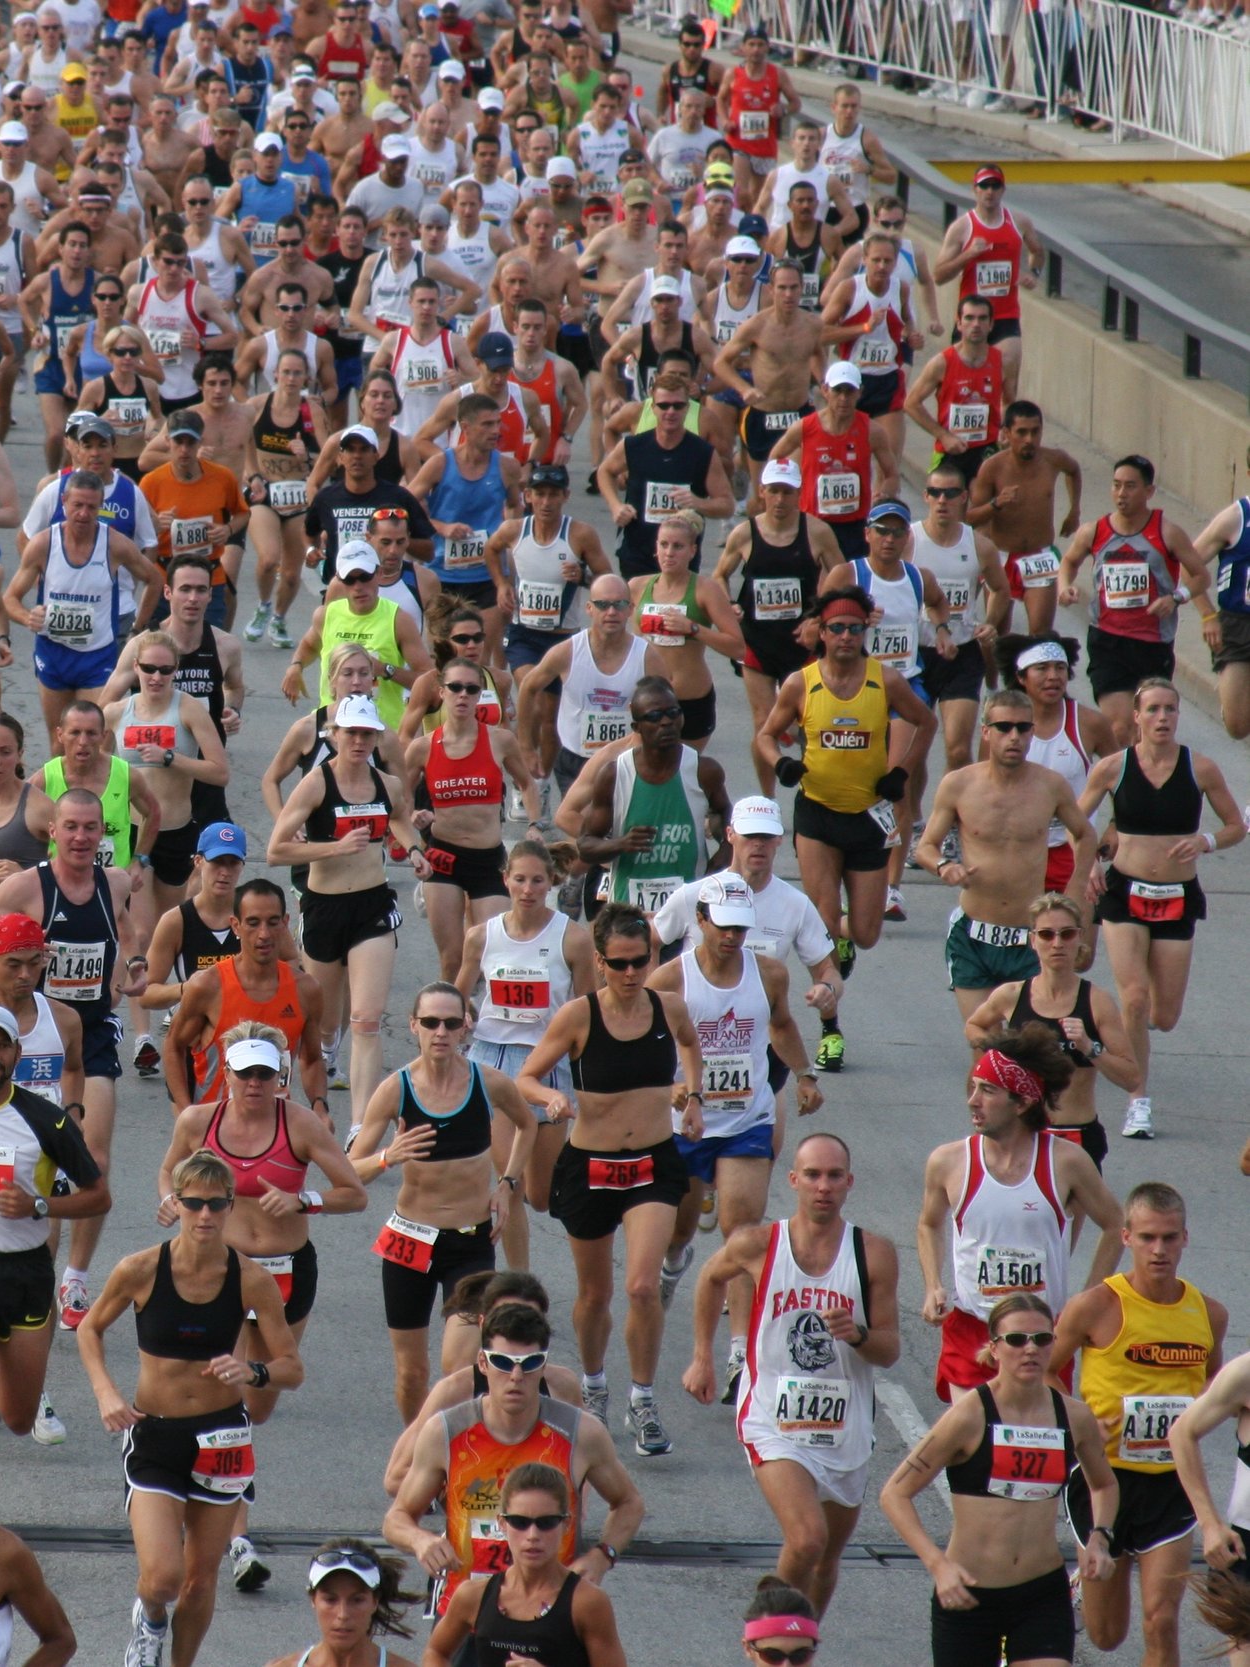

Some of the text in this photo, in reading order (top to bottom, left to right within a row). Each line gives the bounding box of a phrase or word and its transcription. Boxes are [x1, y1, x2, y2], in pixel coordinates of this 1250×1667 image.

[861, 349, 888, 363] A 817
[408, 366, 438, 380] A 906
[123, 408, 143, 423] 988
[954, 413, 984, 428] A 862
[823, 484, 855, 499] A 863
[339, 520, 364, 532] JOSE
[176, 531, 183, 543] A
[450, 543, 484, 557] A 876
[1024, 559, 1054, 575] A 997
[1105, 574, 1147, 591] A 1799
[518, 591, 559, 610] A 1804
[755, 588, 800, 605] A 1340
[49, 612, 91, 629] 20328
[872, 635, 907, 653] A 750
[184, 669, 210, 679] YORK
[587, 723, 625, 741] A 865
[823, 732, 867, 748] Quién
[435, 777, 486, 789] GREATER
[435, 789, 487, 799] BOSTON
[745, 805, 776, 815] TIMEX
[662, 824, 691, 844] FOR
[978, 924, 1020, 945] A 836
[48, 957, 103, 978] A 1499
[503, 984, 534, 1005] 136
[699, 1030, 751, 1041] ATLANTA
[729, 1037, 750, 1048] CLUB
[709, 1070, 750, 1091] 1241
[605, 1164, 638, 1184] 269
[385, 1236, 416, 1263] 233
[978, 1261, 1044, 1286] A 1501
[772, 1289, 854, 1317] EASTON
[800, 1382, 840, 1392] LaSalle Bank
[777, 1394, 845, 1422] A 1420
[1171, 1402, 1187, 1410] Bank
[1016, 1431, 1058, 1440] LaSalle Bank
[212, 1450, 243, 1475] 309
[1011, 1452, 1047, 1478] 327
[490, 1639, 525, 1651] running
